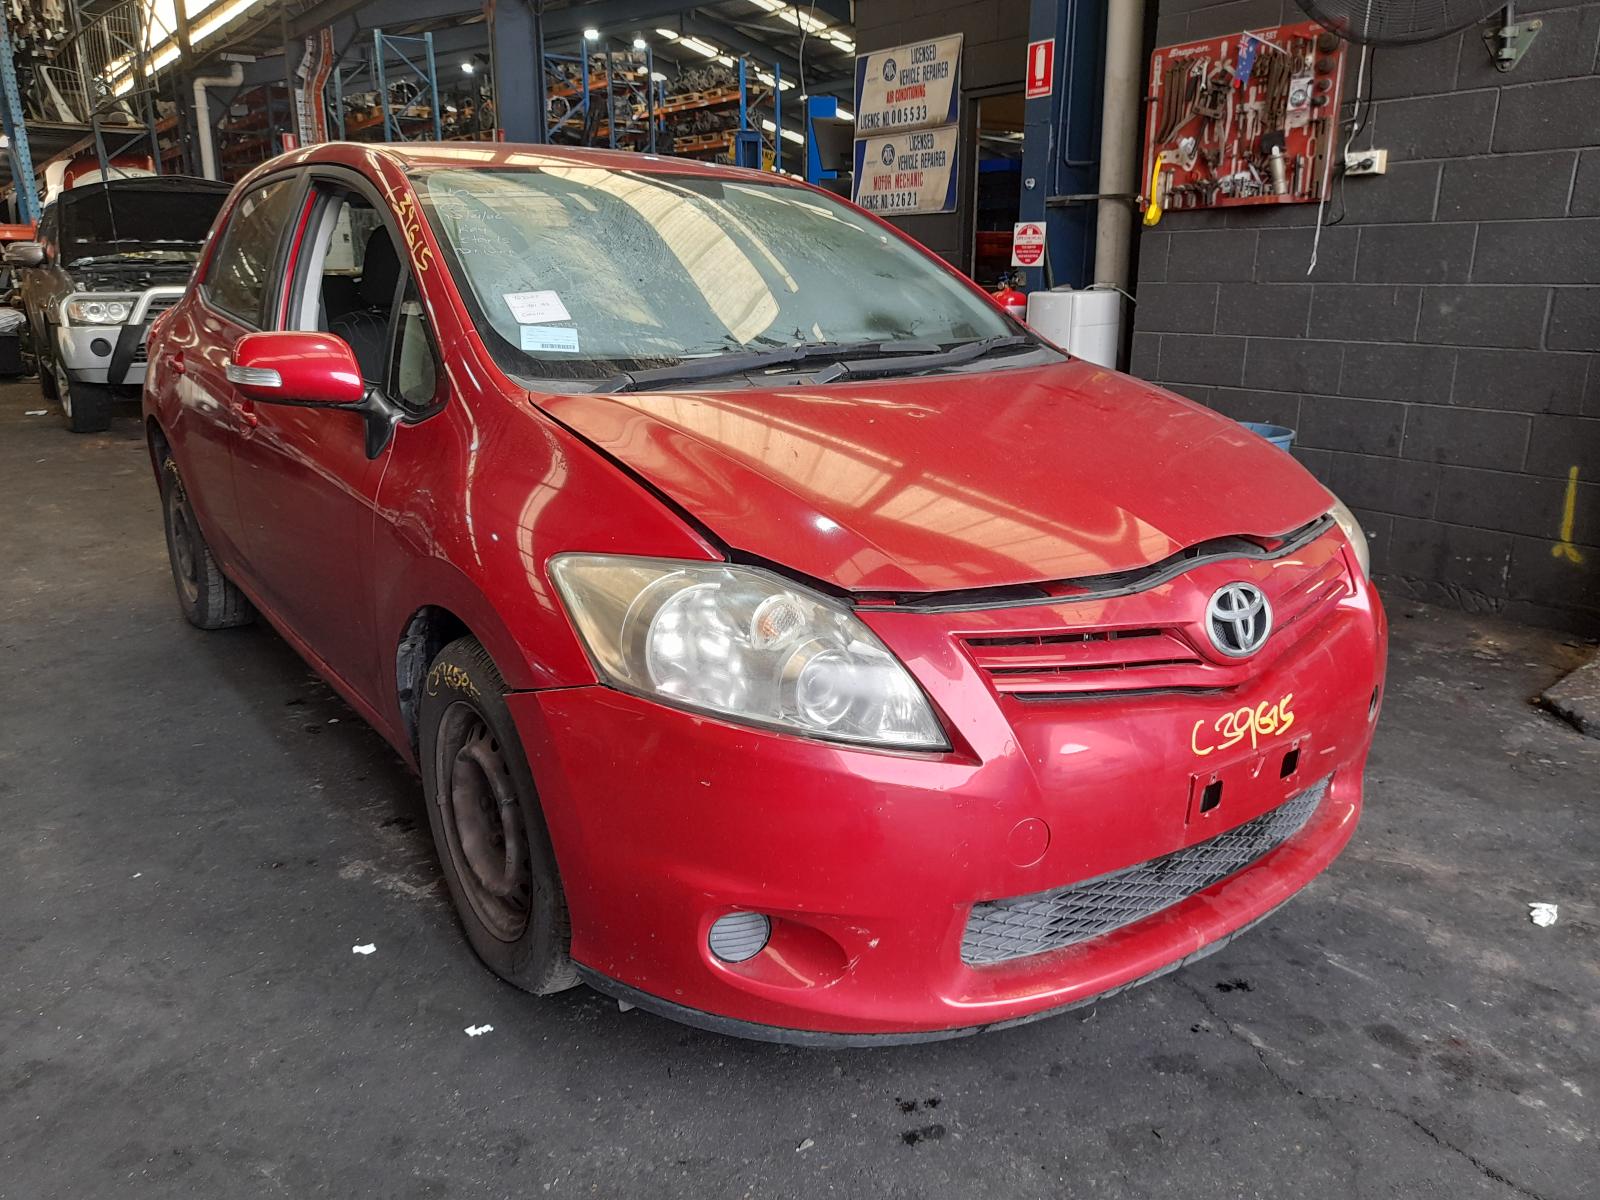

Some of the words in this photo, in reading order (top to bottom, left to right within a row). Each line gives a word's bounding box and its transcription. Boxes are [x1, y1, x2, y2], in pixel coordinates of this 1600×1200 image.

[910, 44, 937, 65] LICENSED
[900, 67, 920, 86] VEHICLE
[923, 61, 949, 81] REPAIRER
[886, 90, 895, 104] AIR
[895, 84, 926, 103] CONDITIONING
[860, 112, 880, 130] LICENCE
[908, 133, 934, 152] LICENSED
[897, 153, 918, 171] VEHICLE
[920, 150, 946, 170] REPAIRER
[873, 175, 892, 192] MOTOR
[895, 171, 924, 190] MECHANIC
[890, 191, 917, 207] 32621
